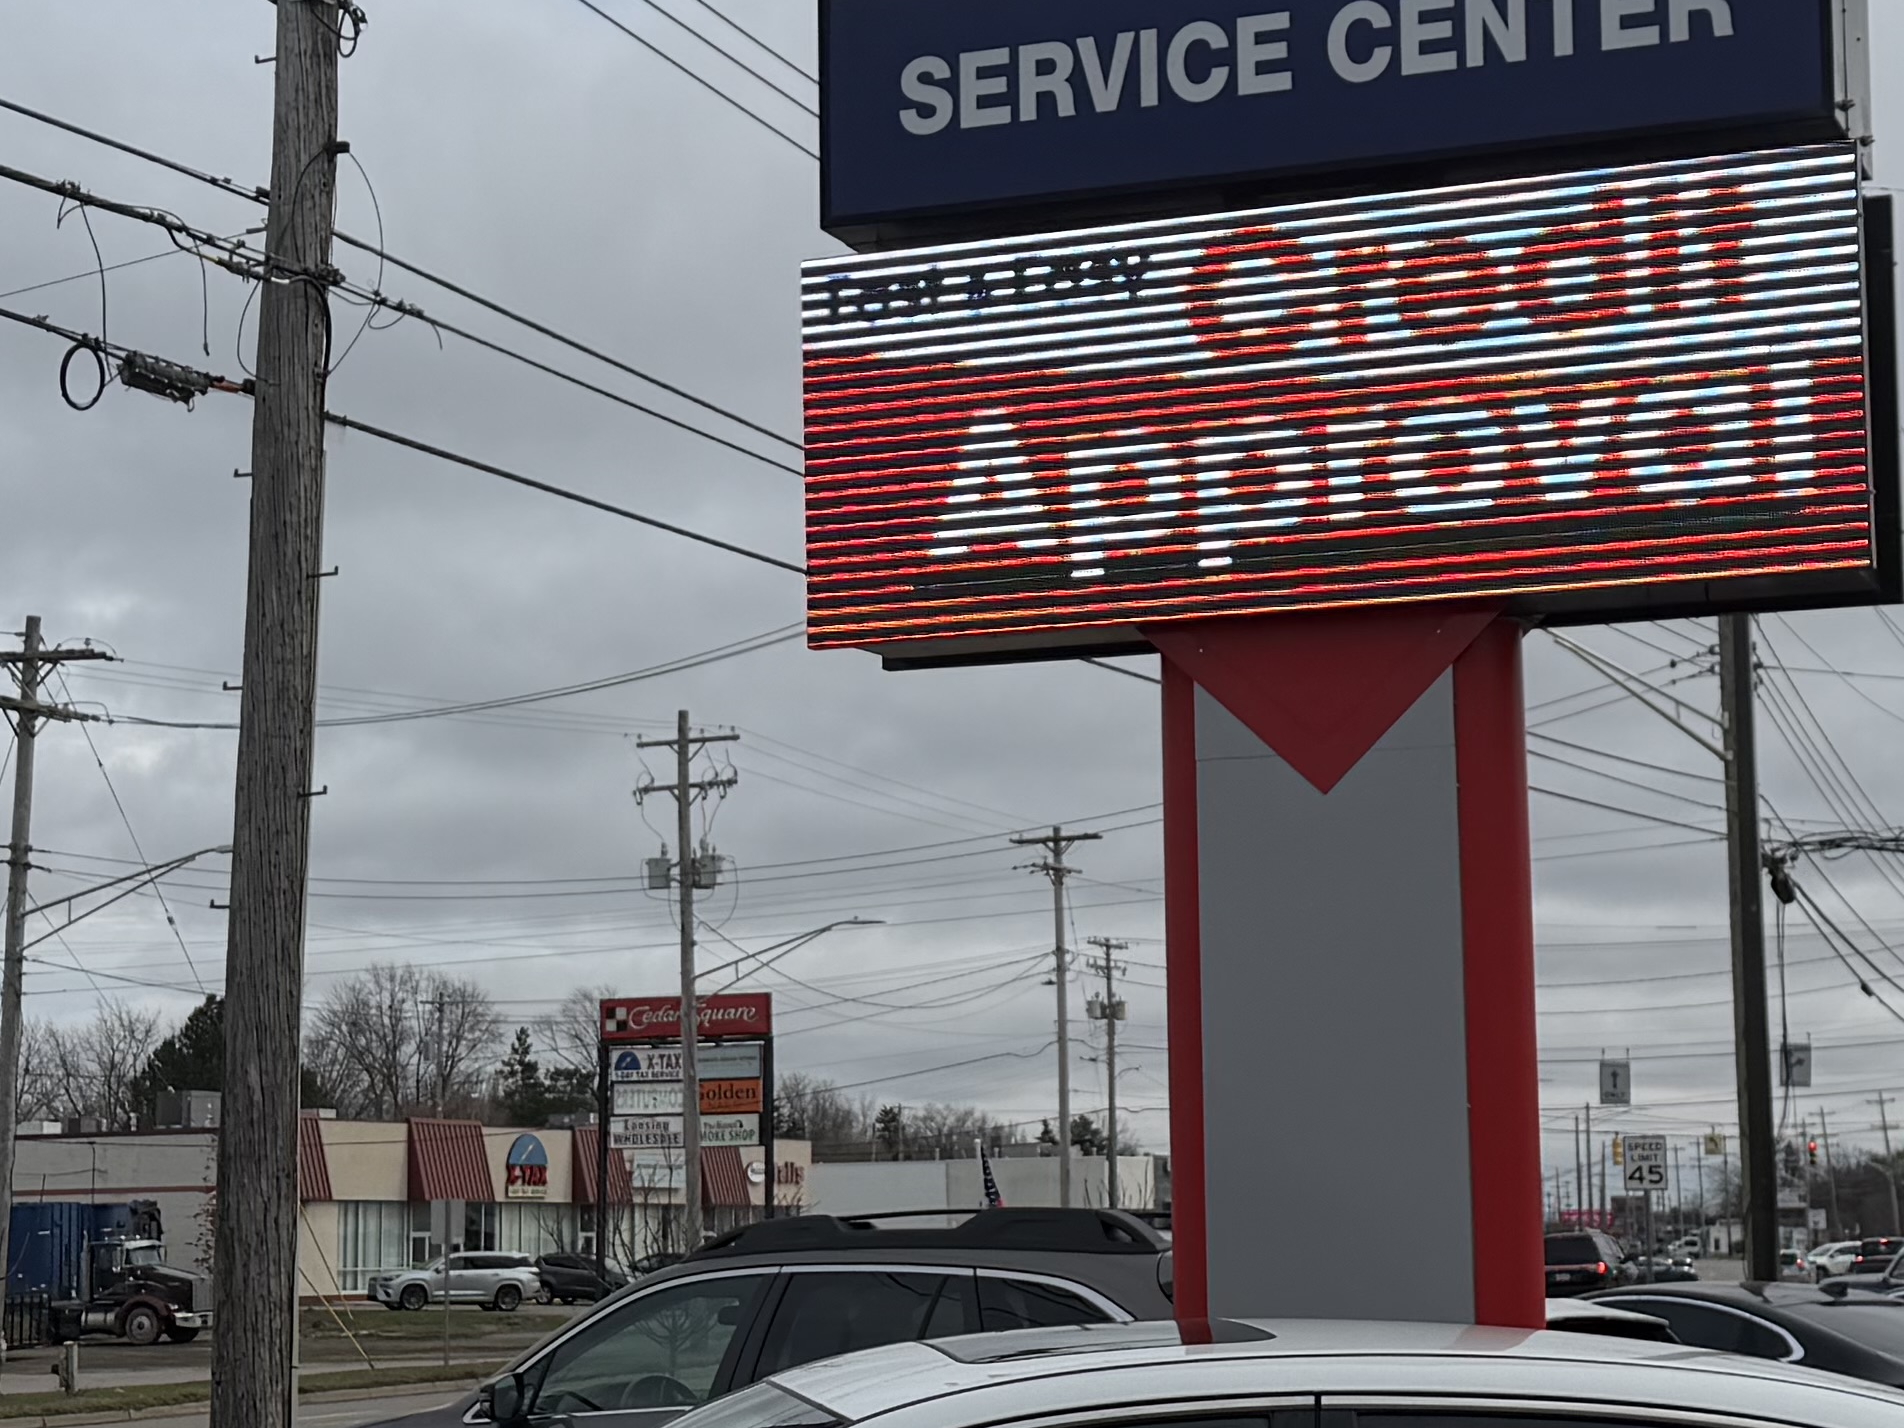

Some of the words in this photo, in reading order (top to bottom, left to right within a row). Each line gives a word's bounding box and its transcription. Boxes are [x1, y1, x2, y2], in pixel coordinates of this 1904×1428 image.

[898, 9, 1293, 136] SERVICE
[1186, 181, 1756, 359] Credit
[927, 357, 1818, 578] Approval
[628, 1004, 680, 1029] Cedar
[647, 1053, 682, 1070] X-TAX
[699, 1130, 725, 1142] MOKE
[729, 1129, 756, 1141] SHOP
[1627, 1141, 1663, 1152] SPEED
[1630, 1153, 1659, 1162] LIMIT
[1628, 1164, 1664, 1185] 45
